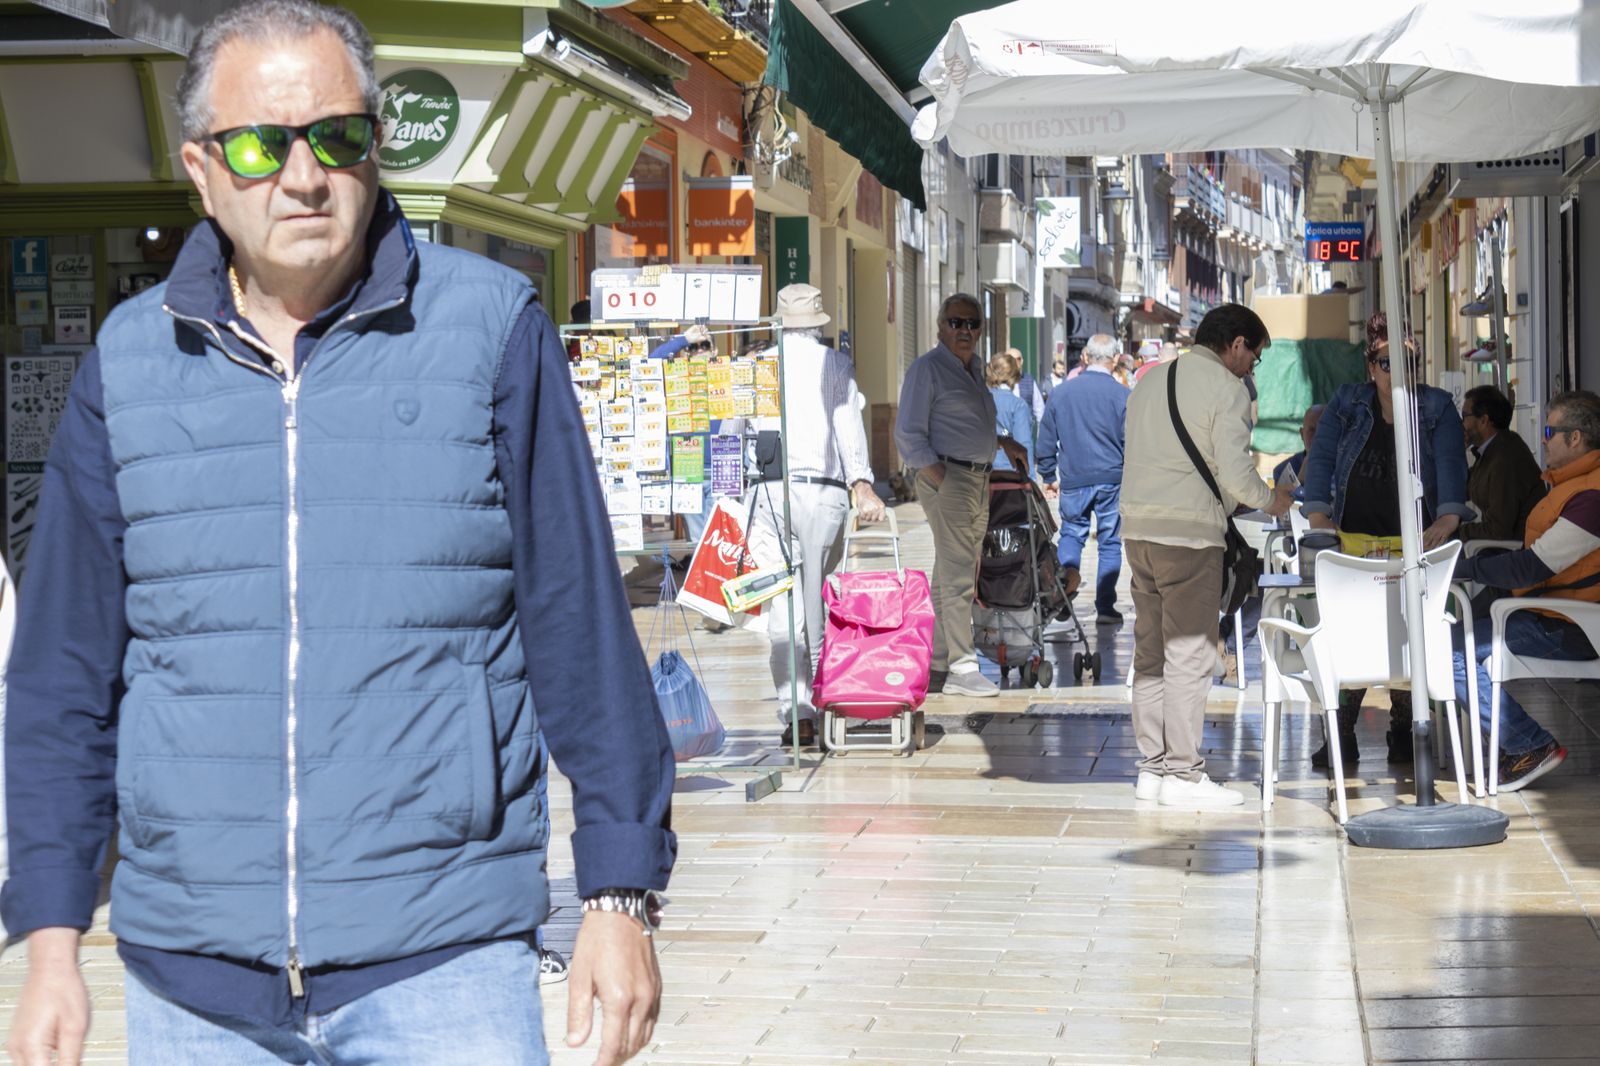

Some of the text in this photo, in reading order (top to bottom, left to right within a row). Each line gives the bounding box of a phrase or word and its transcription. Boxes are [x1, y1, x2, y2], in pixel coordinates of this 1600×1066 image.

[693, 217, 749, 228] bankinter
[1333, 226, 1362, 235] urbano
[1314, 241, 1330, 261] 18
